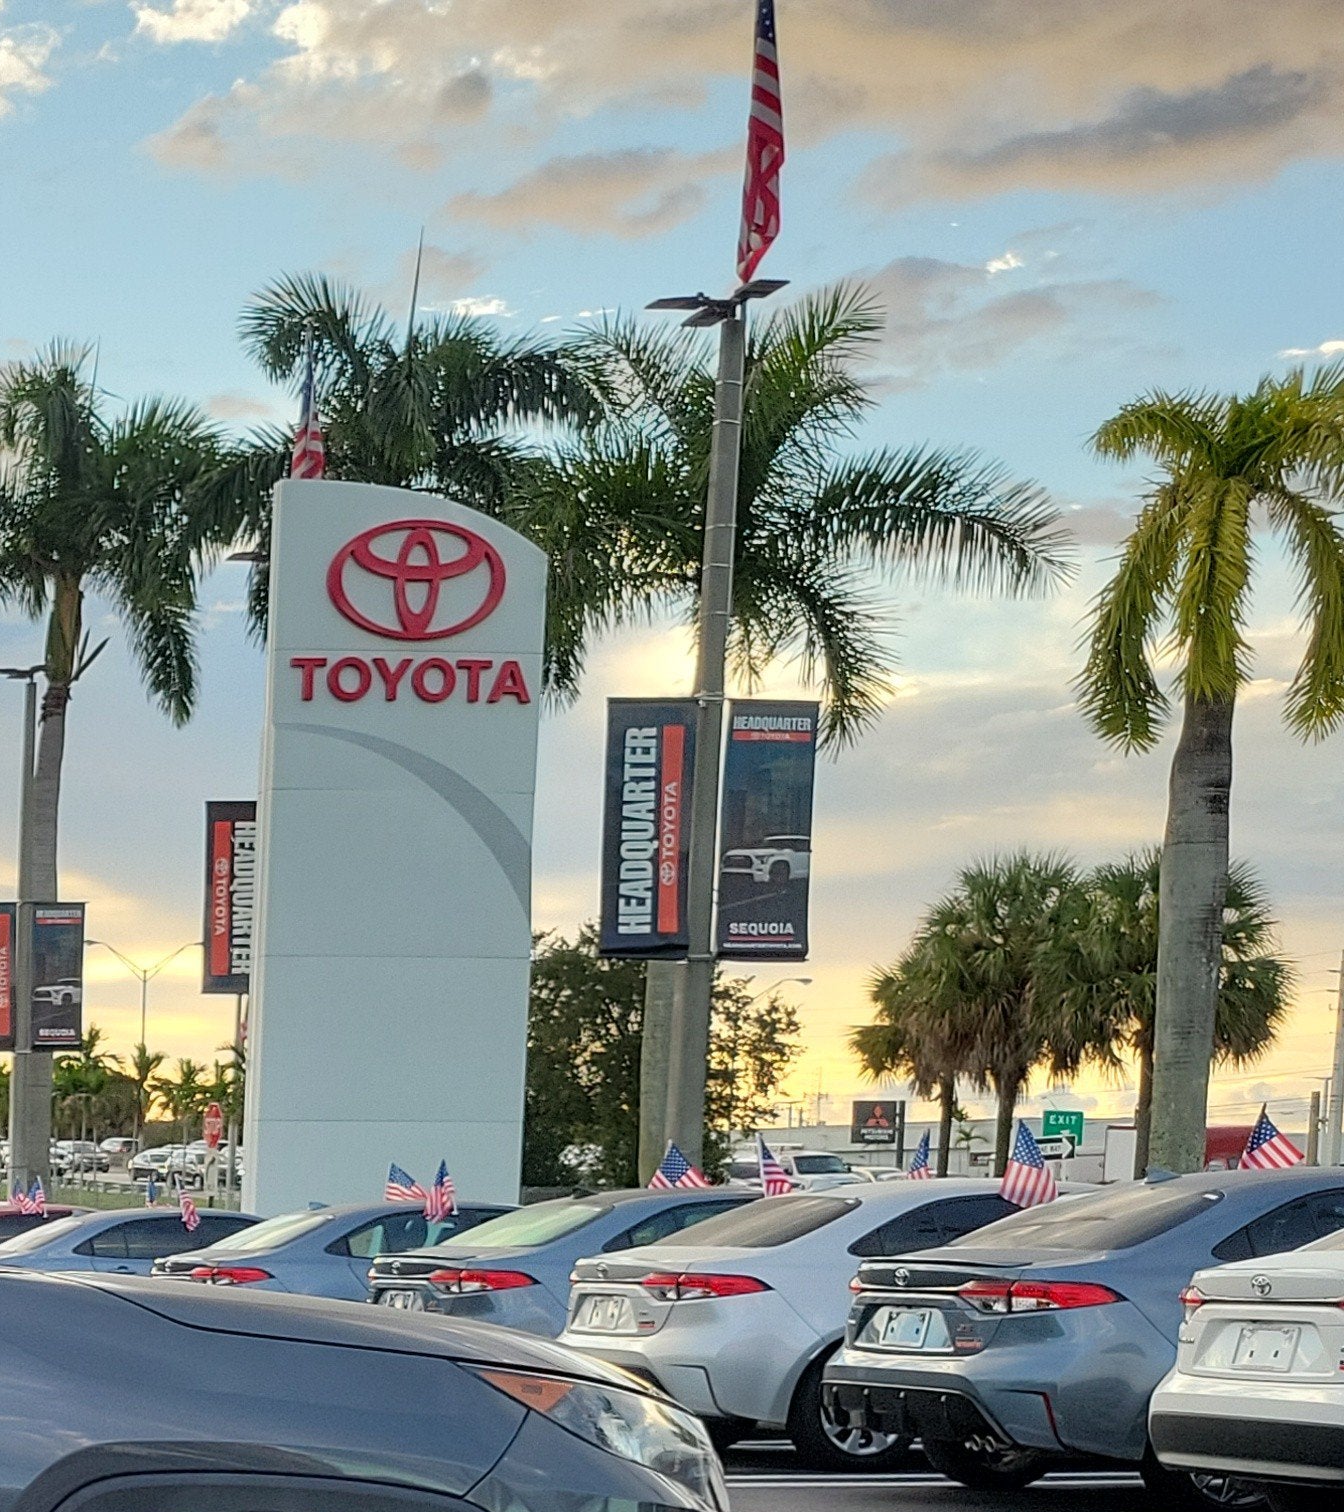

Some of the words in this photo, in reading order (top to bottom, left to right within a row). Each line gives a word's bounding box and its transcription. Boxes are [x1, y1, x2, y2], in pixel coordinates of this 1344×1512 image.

[290, 656, 531, 704] TOYOTA
[733, 716, 811, 732] HEADQUARTER
[617, 726, 658, 935] HEADQUARTER
[662, 781, 678, 860] TOYOTA
[214, 880, 227, 937] TOYOTA
[229, 821, 256, 975] HEADQUARTER
[729, 922, 795, 936] SEQUOIA
[1049, 1115, 1077, 1125] EXIT
